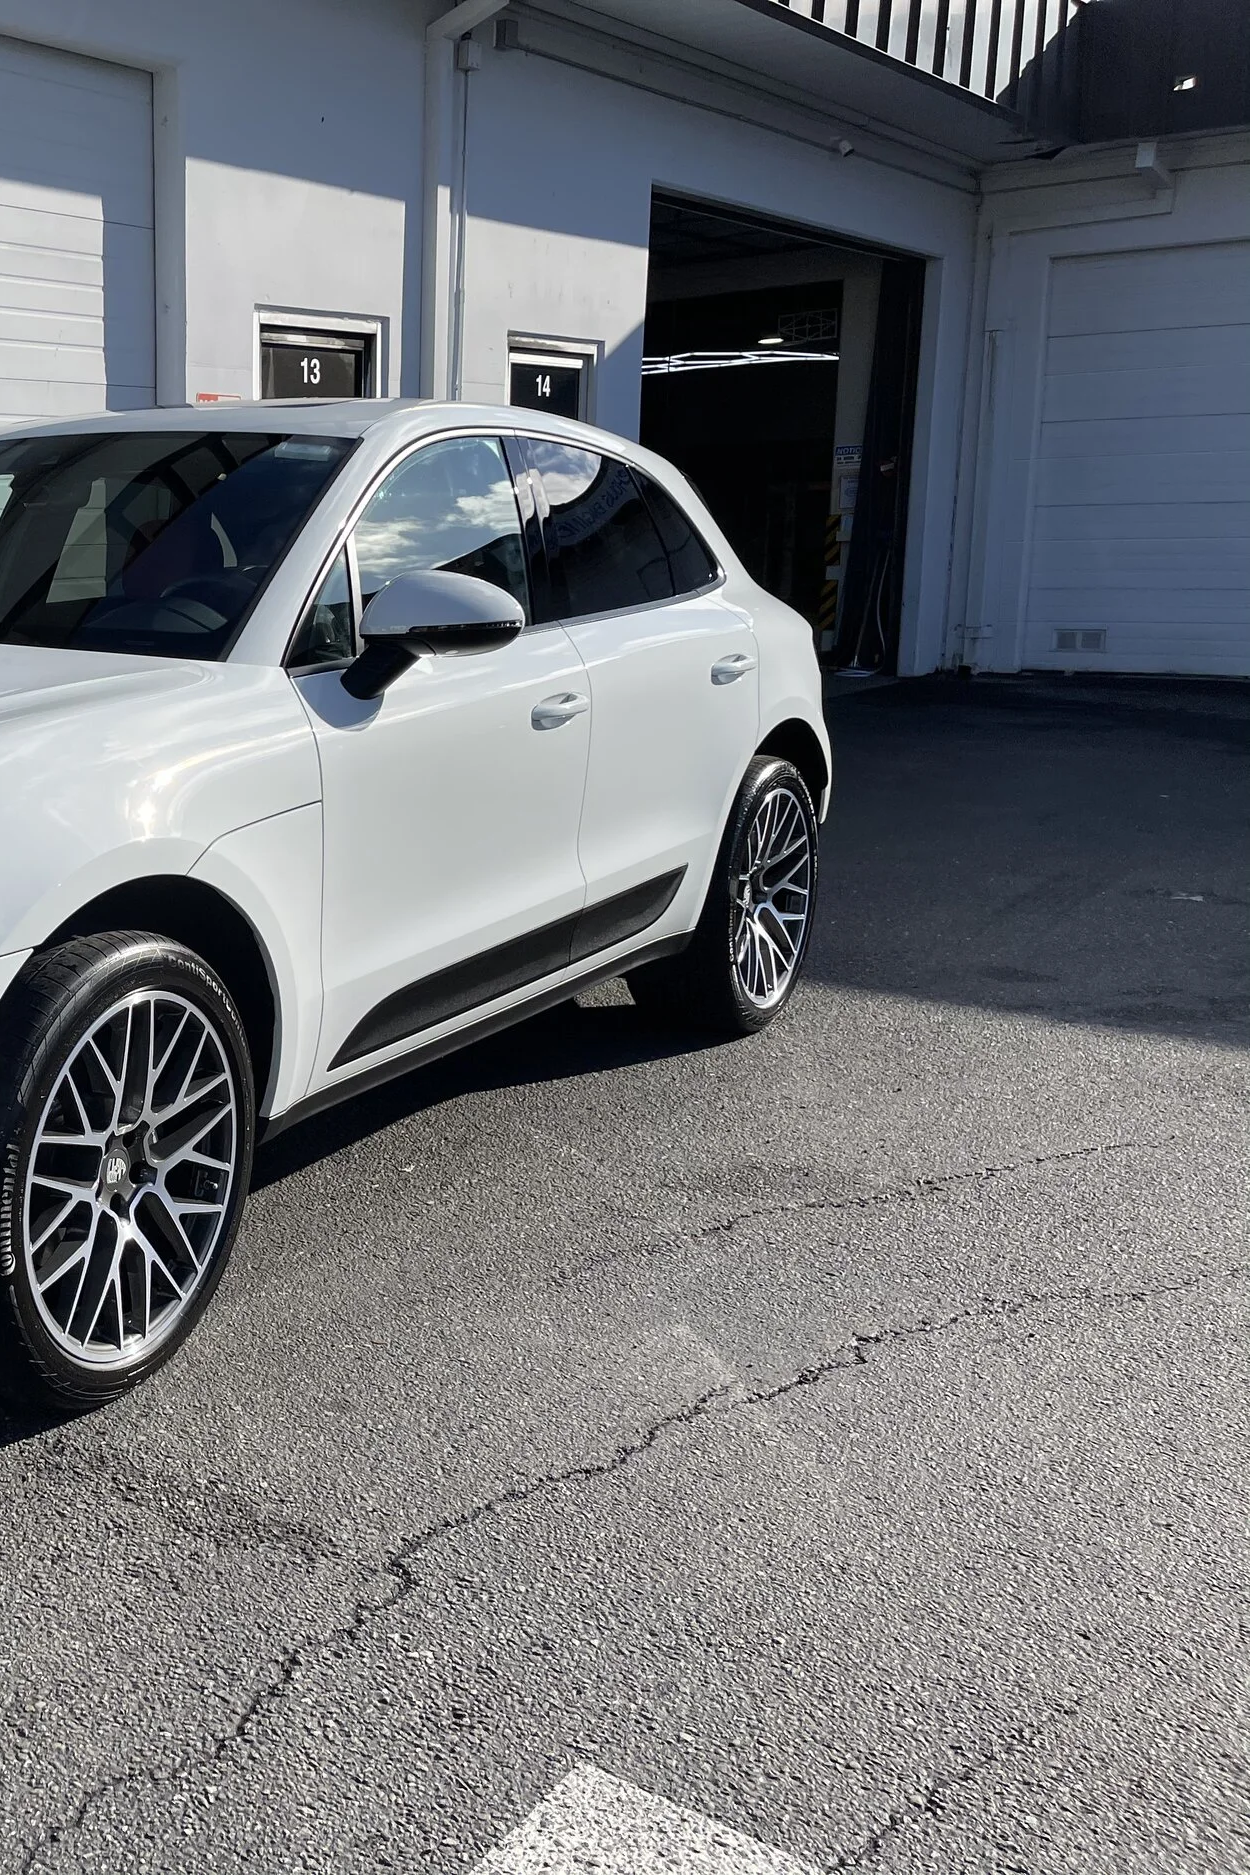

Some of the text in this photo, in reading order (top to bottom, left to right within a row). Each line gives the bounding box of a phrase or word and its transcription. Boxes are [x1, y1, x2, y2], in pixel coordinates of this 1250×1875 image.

[300, 357, 321, 385] 13
[535, 374, 551, 397] 14
[0, 1143, 21, 1277] Continental
